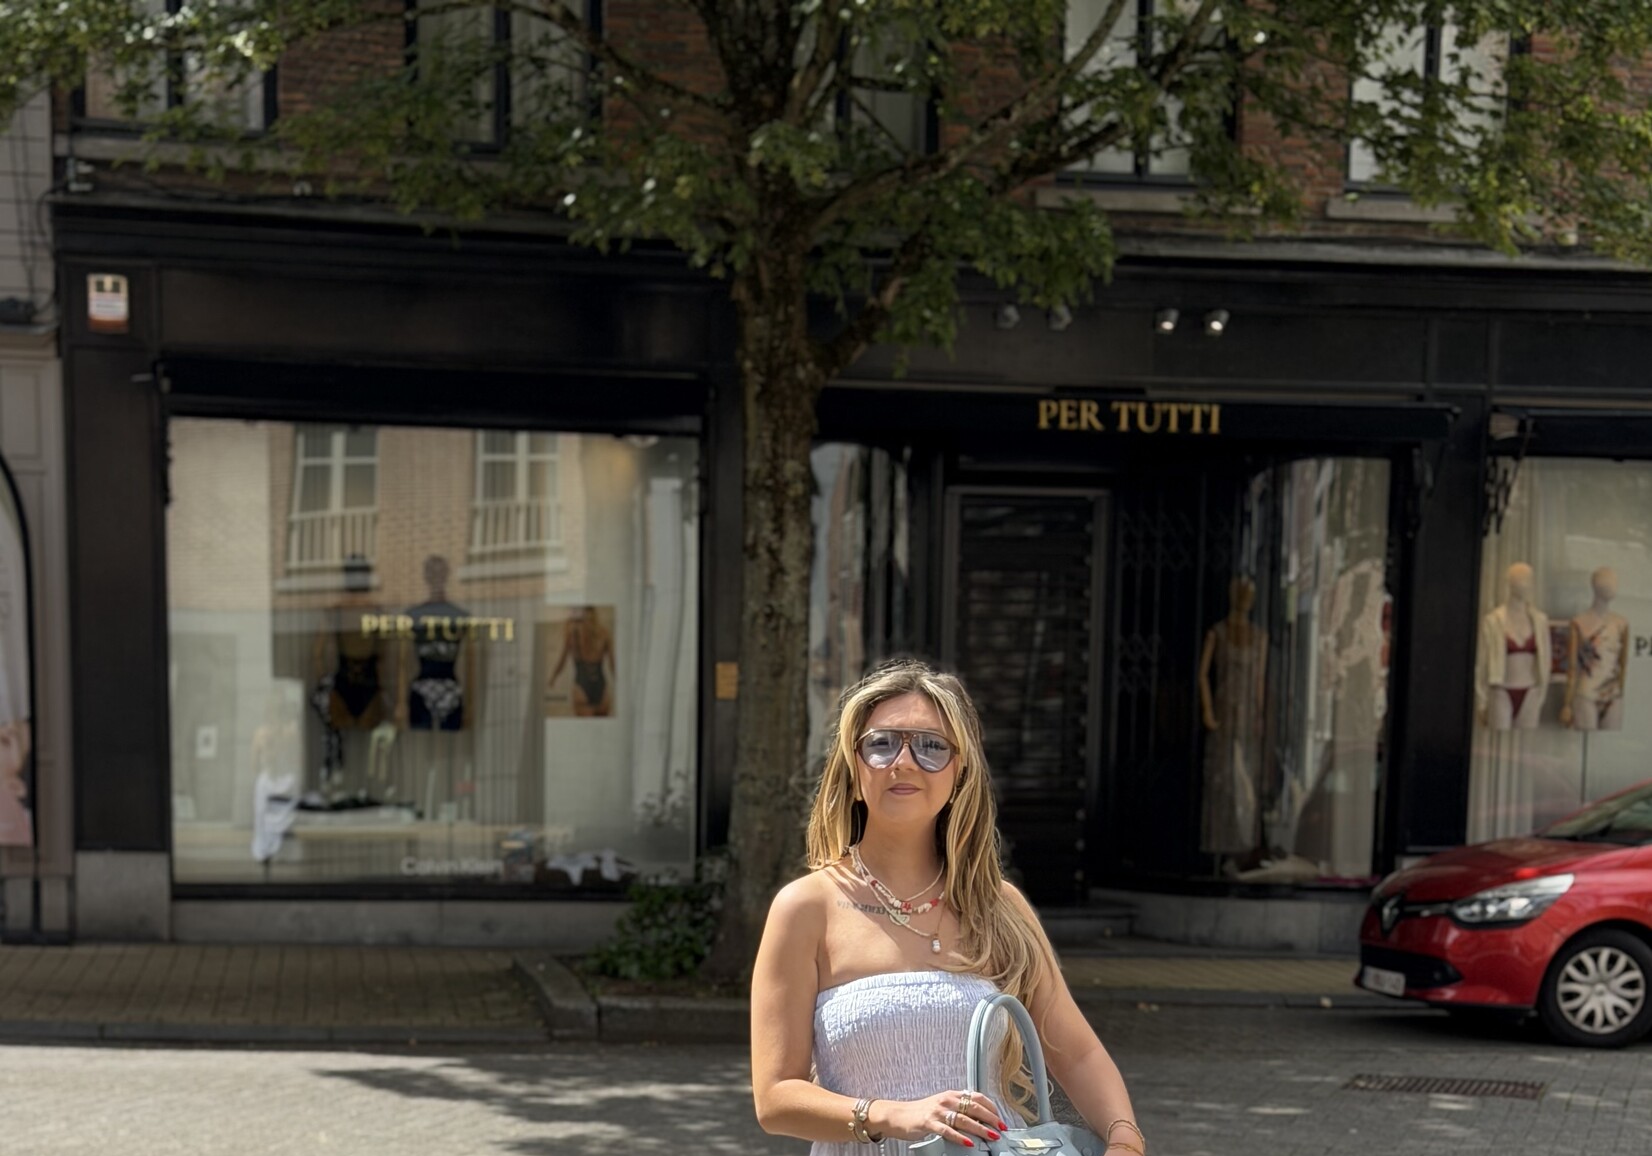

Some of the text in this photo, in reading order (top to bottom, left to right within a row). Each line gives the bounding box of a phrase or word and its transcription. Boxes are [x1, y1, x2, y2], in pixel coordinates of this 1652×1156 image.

[1038, 400, 1220, 433] PER TUTTI
[361, 614, 514, 641] PER TUTTI
